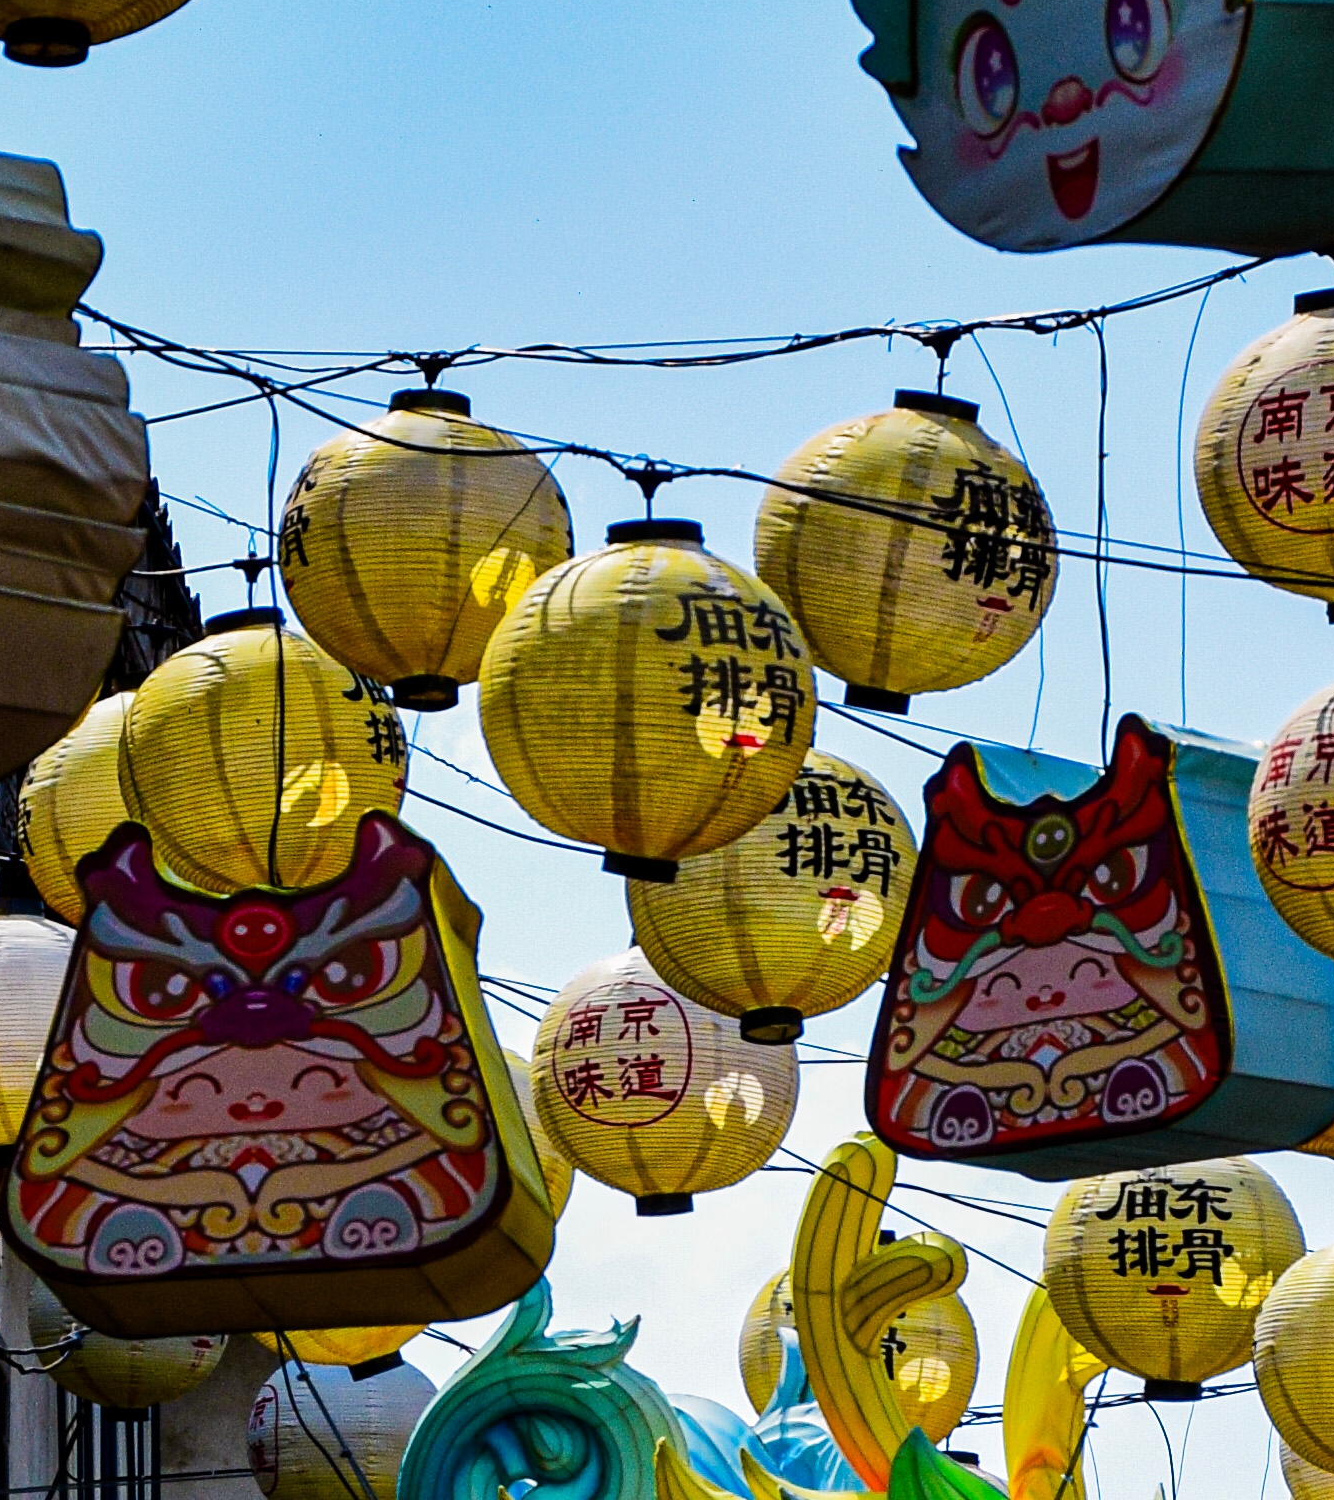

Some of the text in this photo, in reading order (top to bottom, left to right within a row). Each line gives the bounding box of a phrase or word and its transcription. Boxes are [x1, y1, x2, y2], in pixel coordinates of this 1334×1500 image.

[280, 507, 312, 570] 骨
[942, 530, 1051, 611] 排骨
[655, 586, 800, 660] 庙东
[680, 653, 805, 746] 排骨
[367, 709, 405, 767] 排
[769, 766, 895, 826] 庙东
[776, 822, 900, 897] 排骨
[564, 997, 669, 1049] 南京
[564, 1054, 679, 1109] 味道
[1096, 1175, 1233, 1224] 庙东
[1108, 1226, 1234, 1287] 排骨
